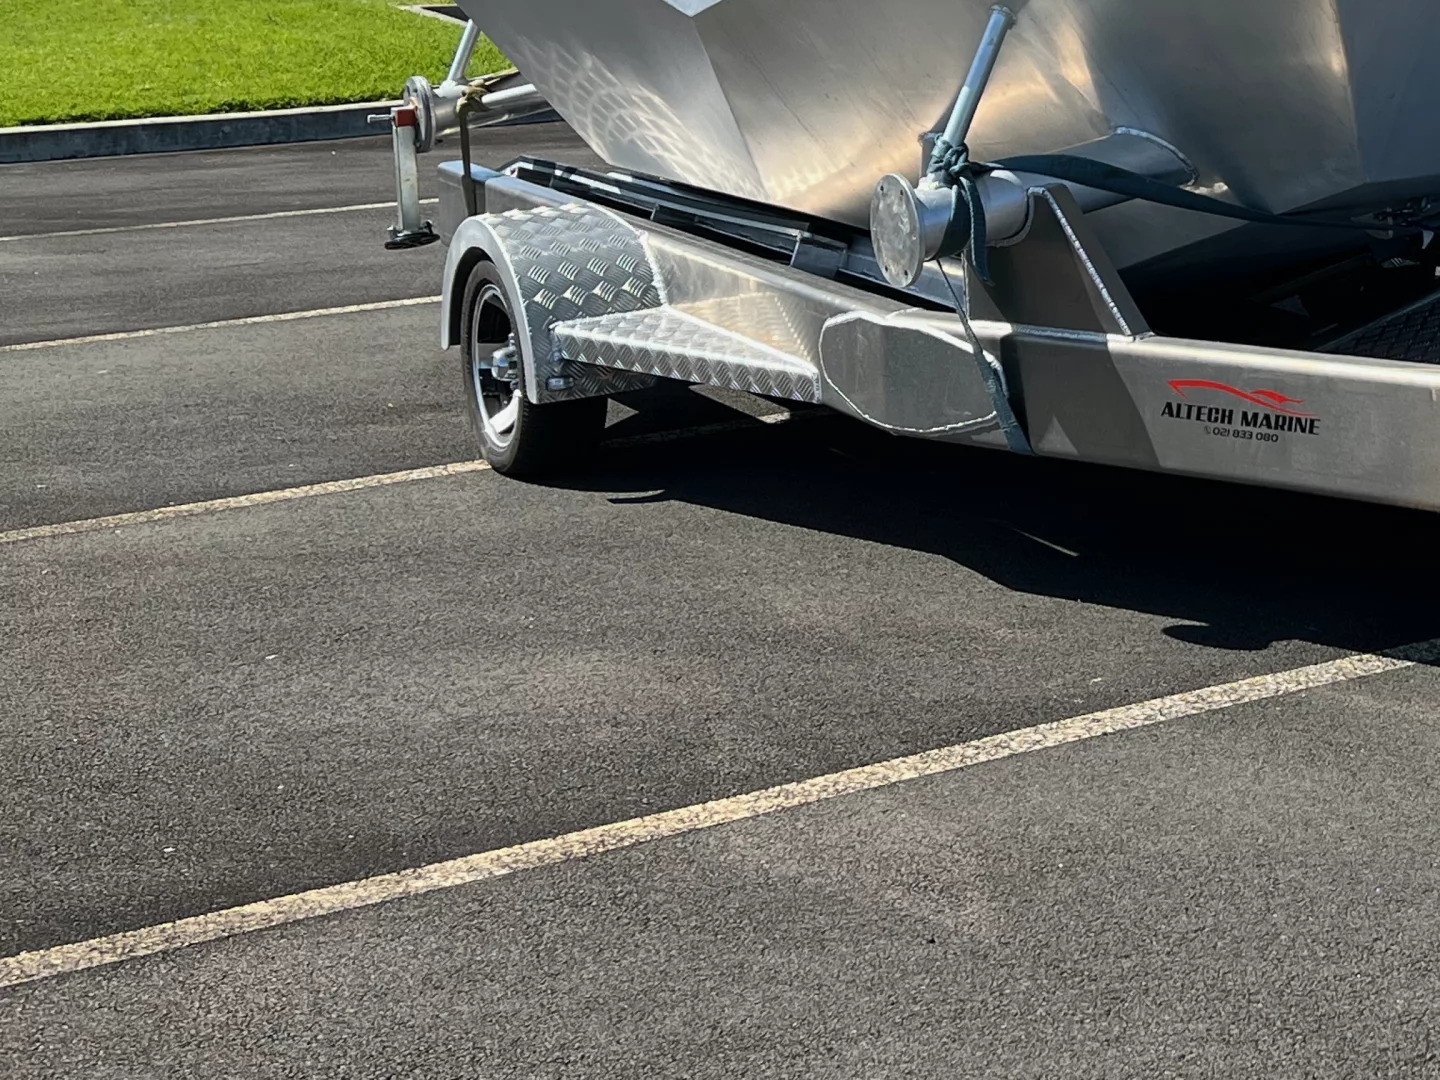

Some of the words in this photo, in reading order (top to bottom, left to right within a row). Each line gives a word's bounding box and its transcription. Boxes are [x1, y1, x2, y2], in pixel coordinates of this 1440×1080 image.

[1161, 402, 1233, 424] ALTECH
[1241, 410, 1321, 435] MARINE
[1213, 428, 1230, 437] 021
[1232, 429, 1253, 440] 833
[1256, 432, 1278, 443] 080
